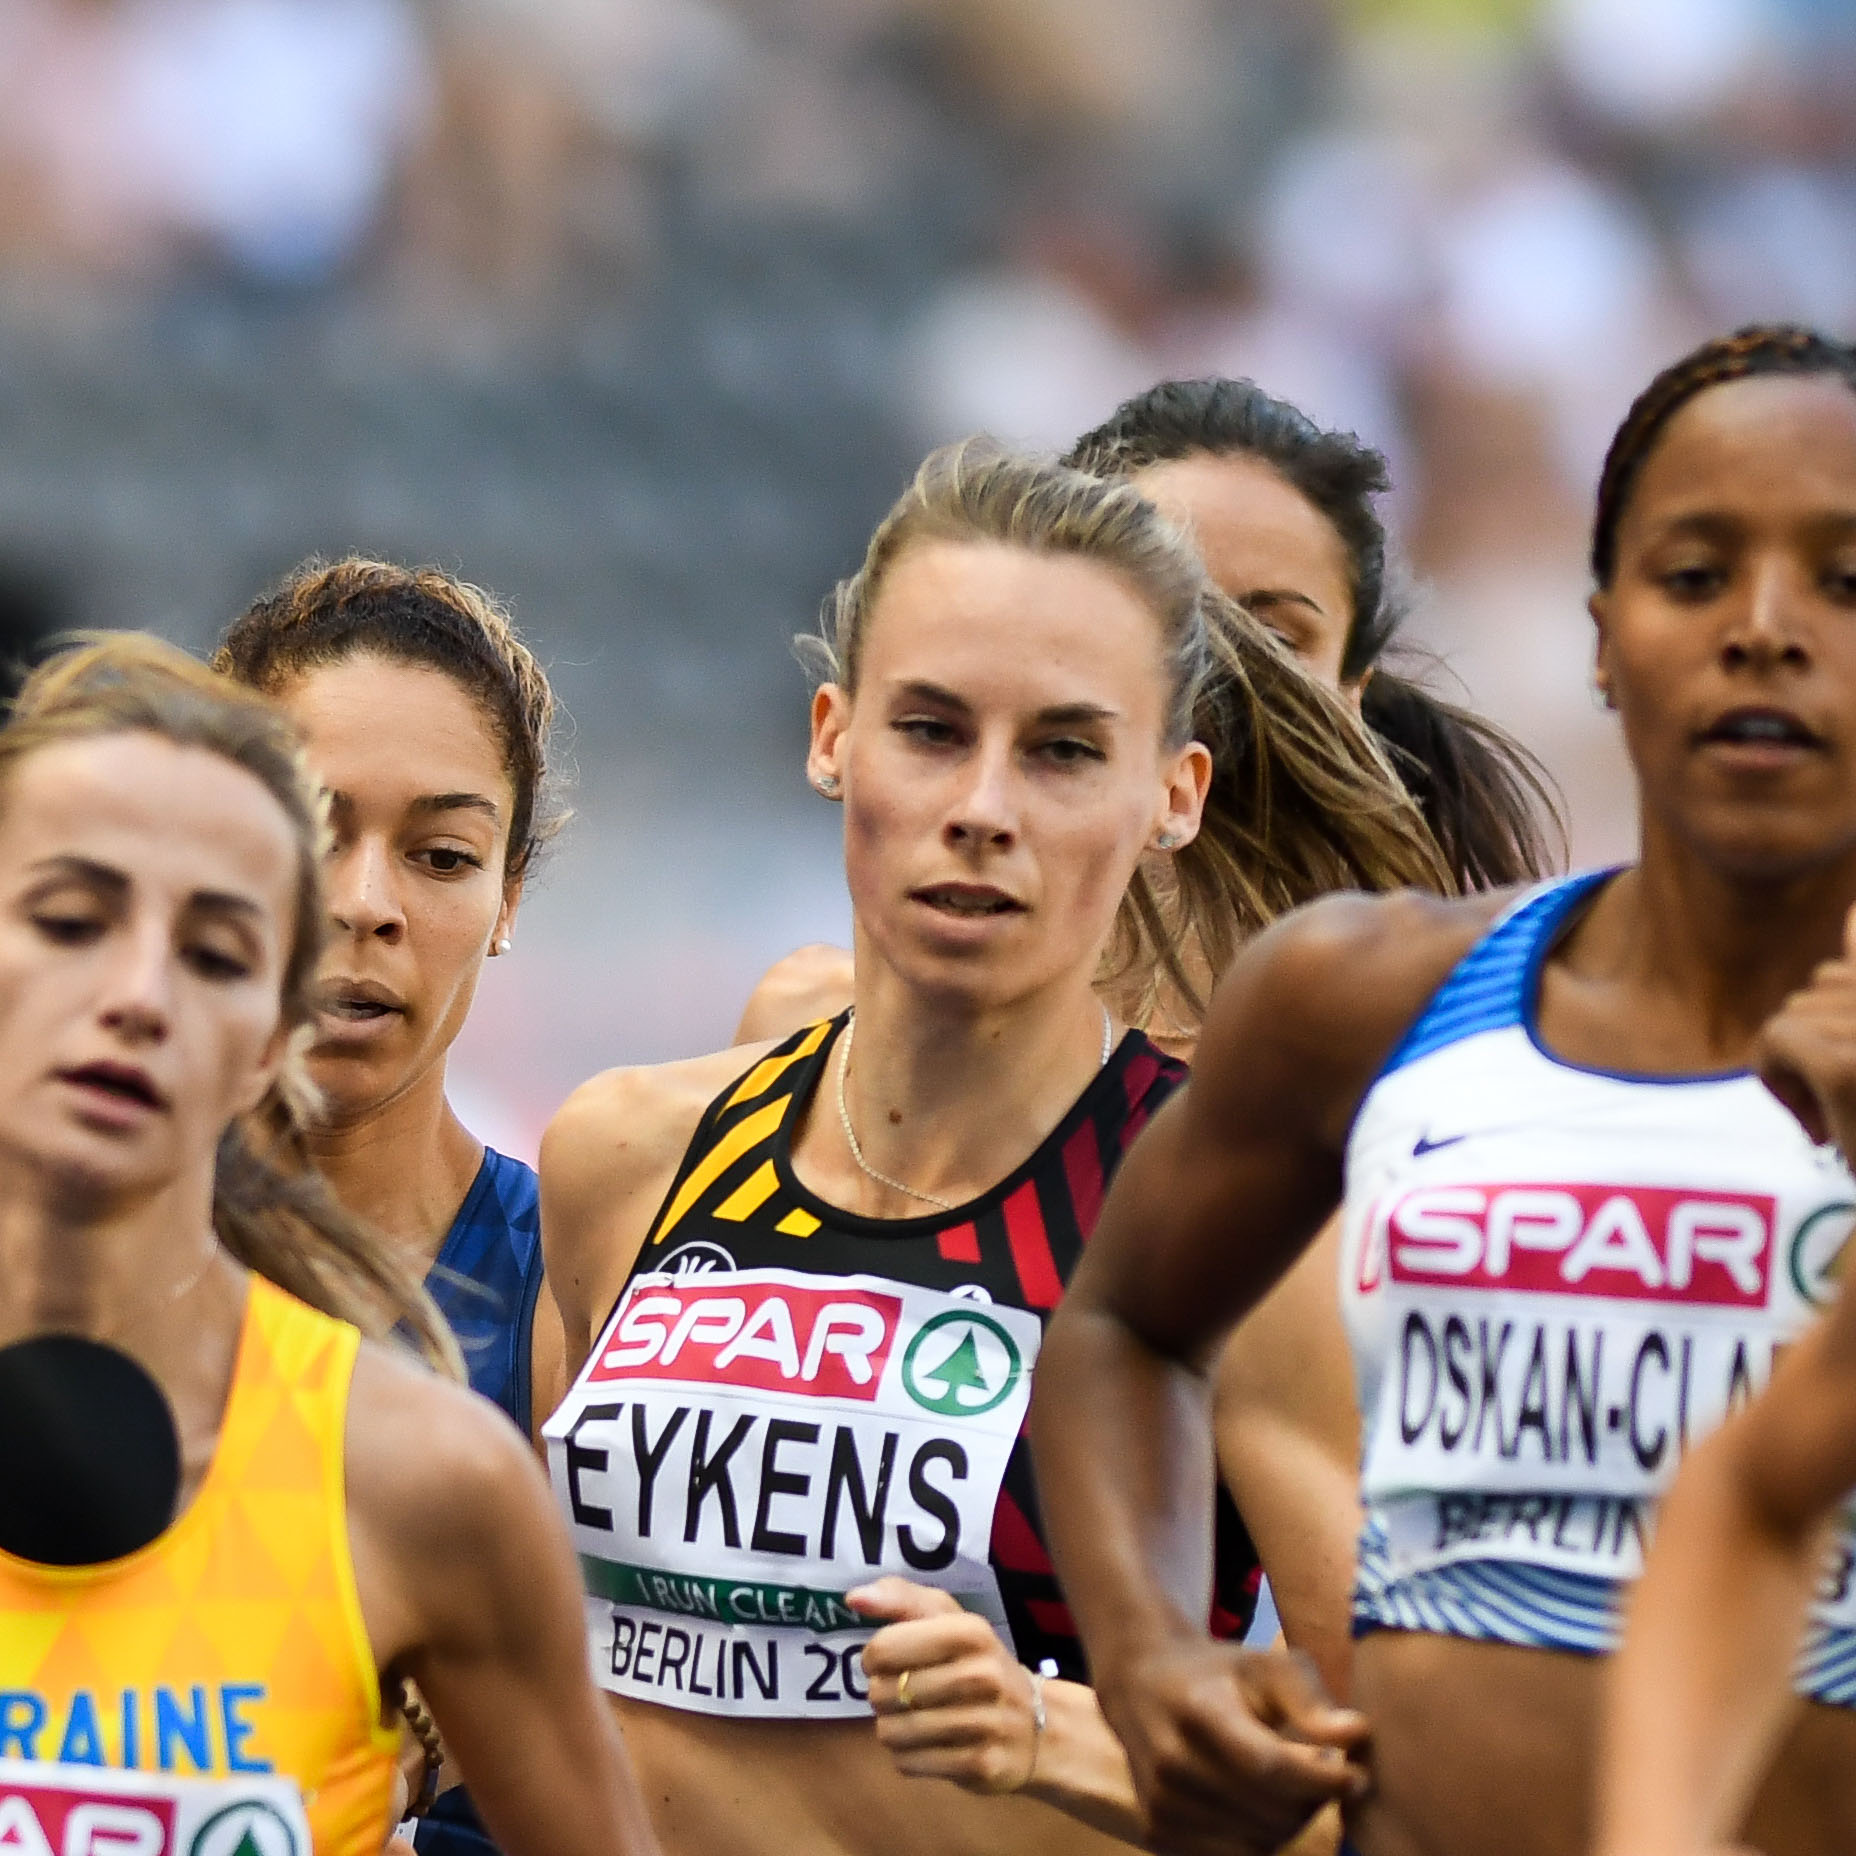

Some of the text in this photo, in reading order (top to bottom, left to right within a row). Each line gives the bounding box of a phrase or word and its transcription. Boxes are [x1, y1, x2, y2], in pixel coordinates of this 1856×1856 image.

[1392, 1189, 1765, 1294] SPAR
[603, 1297, 885, 1385] SPAR
[1401, 1311, 1789, 1471] OSKAN-CLA
[567, 1403, 969, 1572] EYKENS
[652, 1576, 719, 1616] RUN
[728, 1587, 862, 1628] CLEAN
[610, 1614, 870, 1703] BERLIN 20
